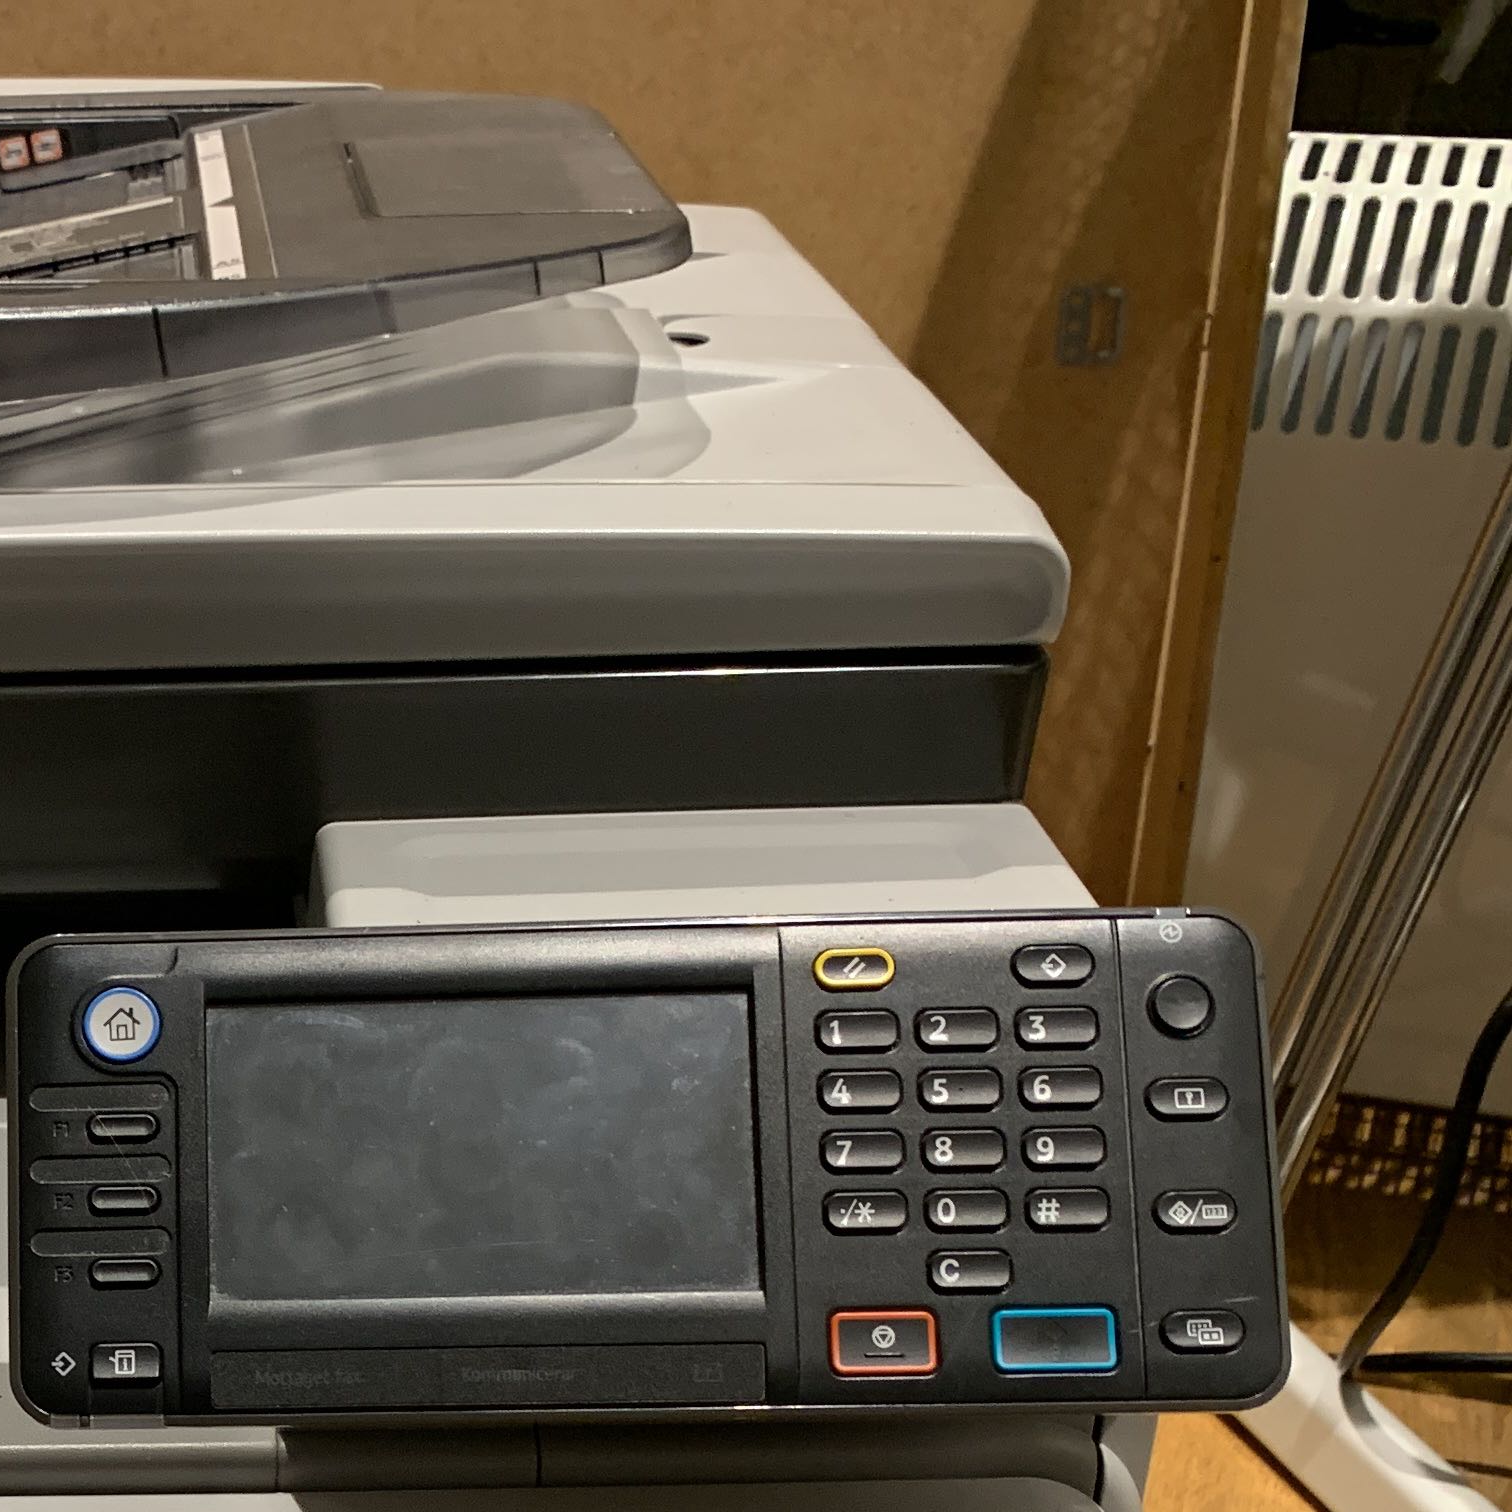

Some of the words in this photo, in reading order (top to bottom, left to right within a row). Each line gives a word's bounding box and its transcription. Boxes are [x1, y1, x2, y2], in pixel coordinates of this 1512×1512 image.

[828, 1019, 842, 1045] 1
[929, 1016, 949, 1042] 2
[1027, 1015, 1047, 1041] 3
[830, 1077, 853, 1104] 4
[931, 1078, 949, 1103] 5
[1033, 1075, 1052, 1101] 6
[836, 1140, 853, 1166] 7
[933, 1137, 954, 1163] 8
[1035, 1136, 1056, 1162] 9
[936, 1198, 956, 1224] 0
[1037, 1198, 1061, 1223] #
[939, 1258, 961, 1284] C
